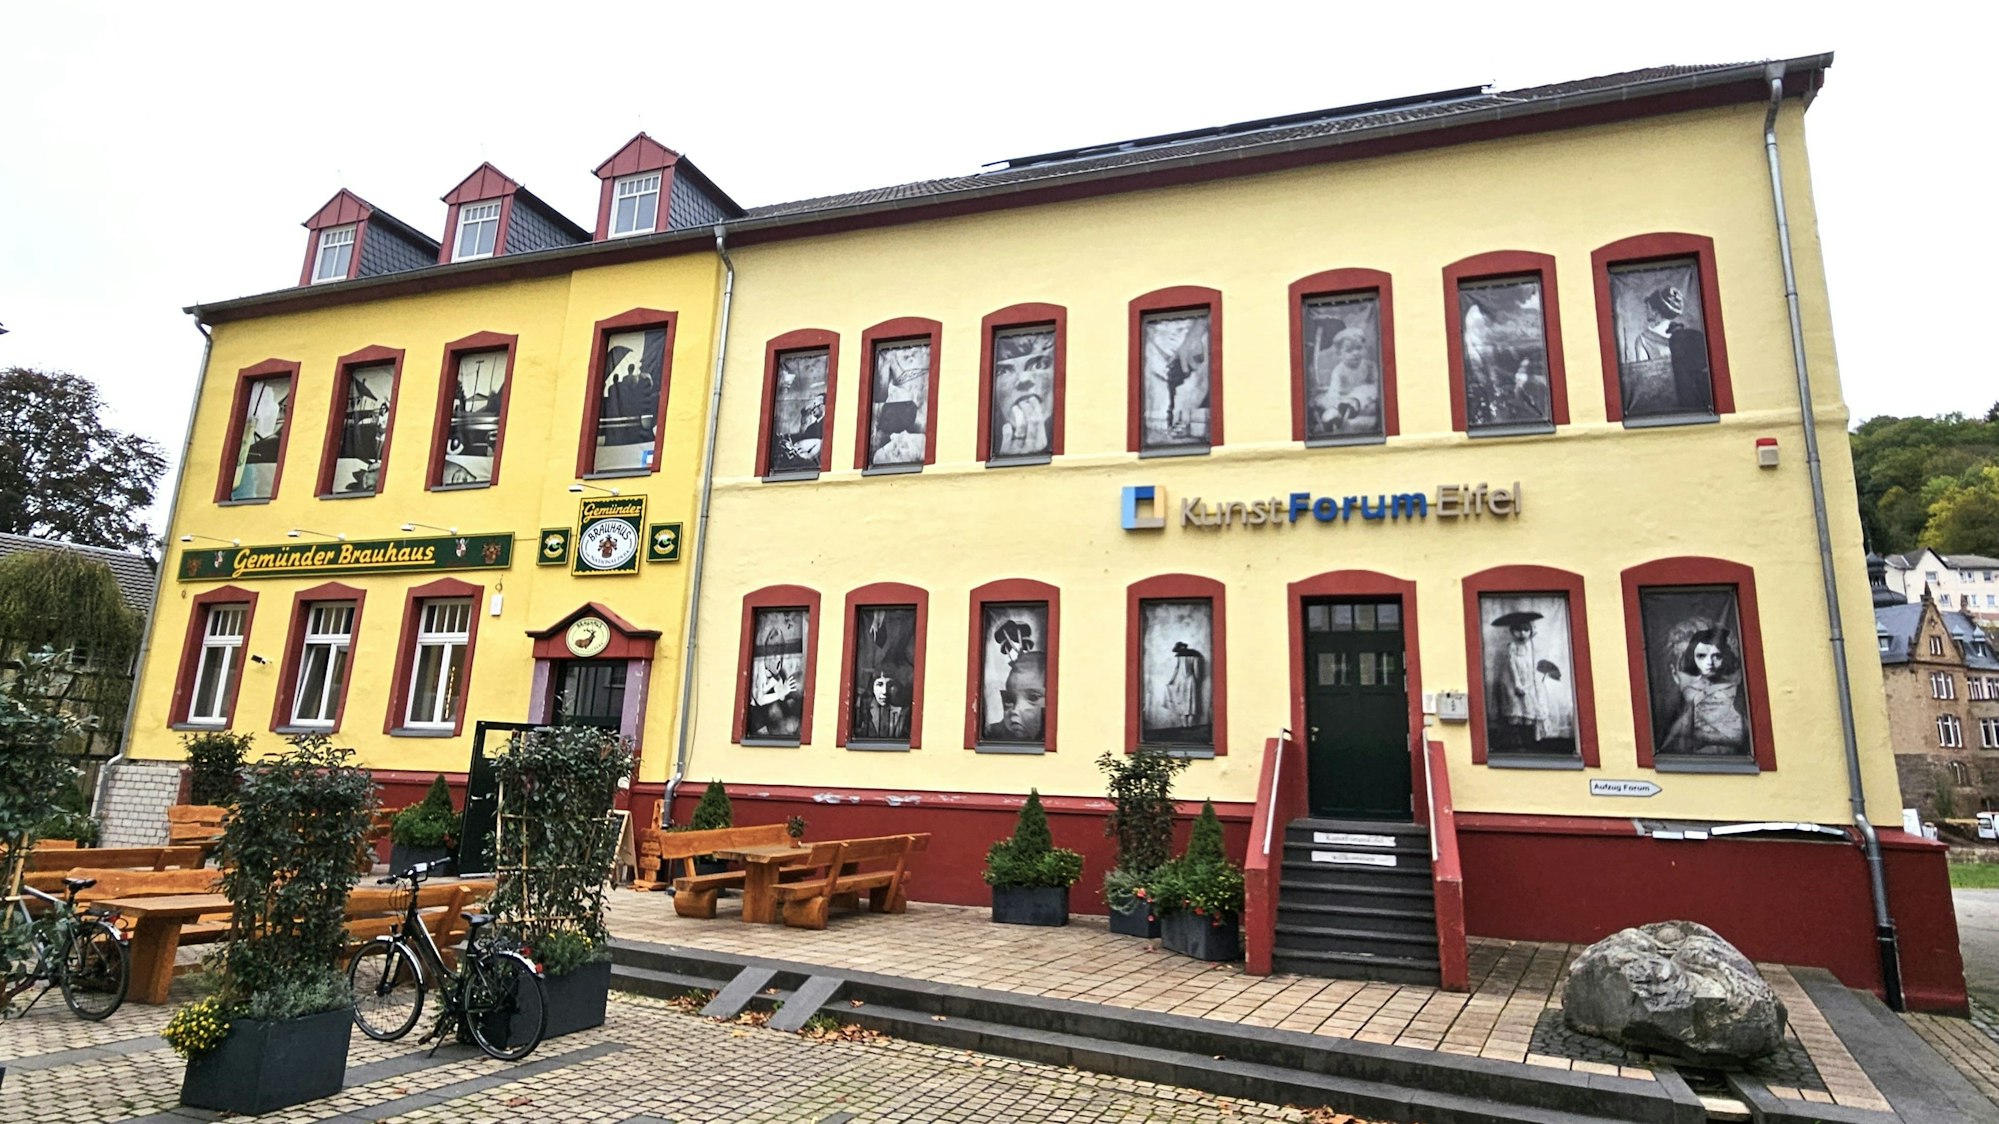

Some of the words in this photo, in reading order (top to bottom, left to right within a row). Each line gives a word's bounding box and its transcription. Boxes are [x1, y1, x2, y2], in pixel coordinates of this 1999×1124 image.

[1436, 482, 1521, 517] Eifel
[583, 503, 641, 523] Gemünder
[587, 522, 632, 542] BRAUHAUS
[232, 545, 335, 577] Gemünder
[338, 542, 435, 565] Brauhaus
[1594, 783, 1622, 792] Aufzug
[1623, 784, 1650, 792] Forum
